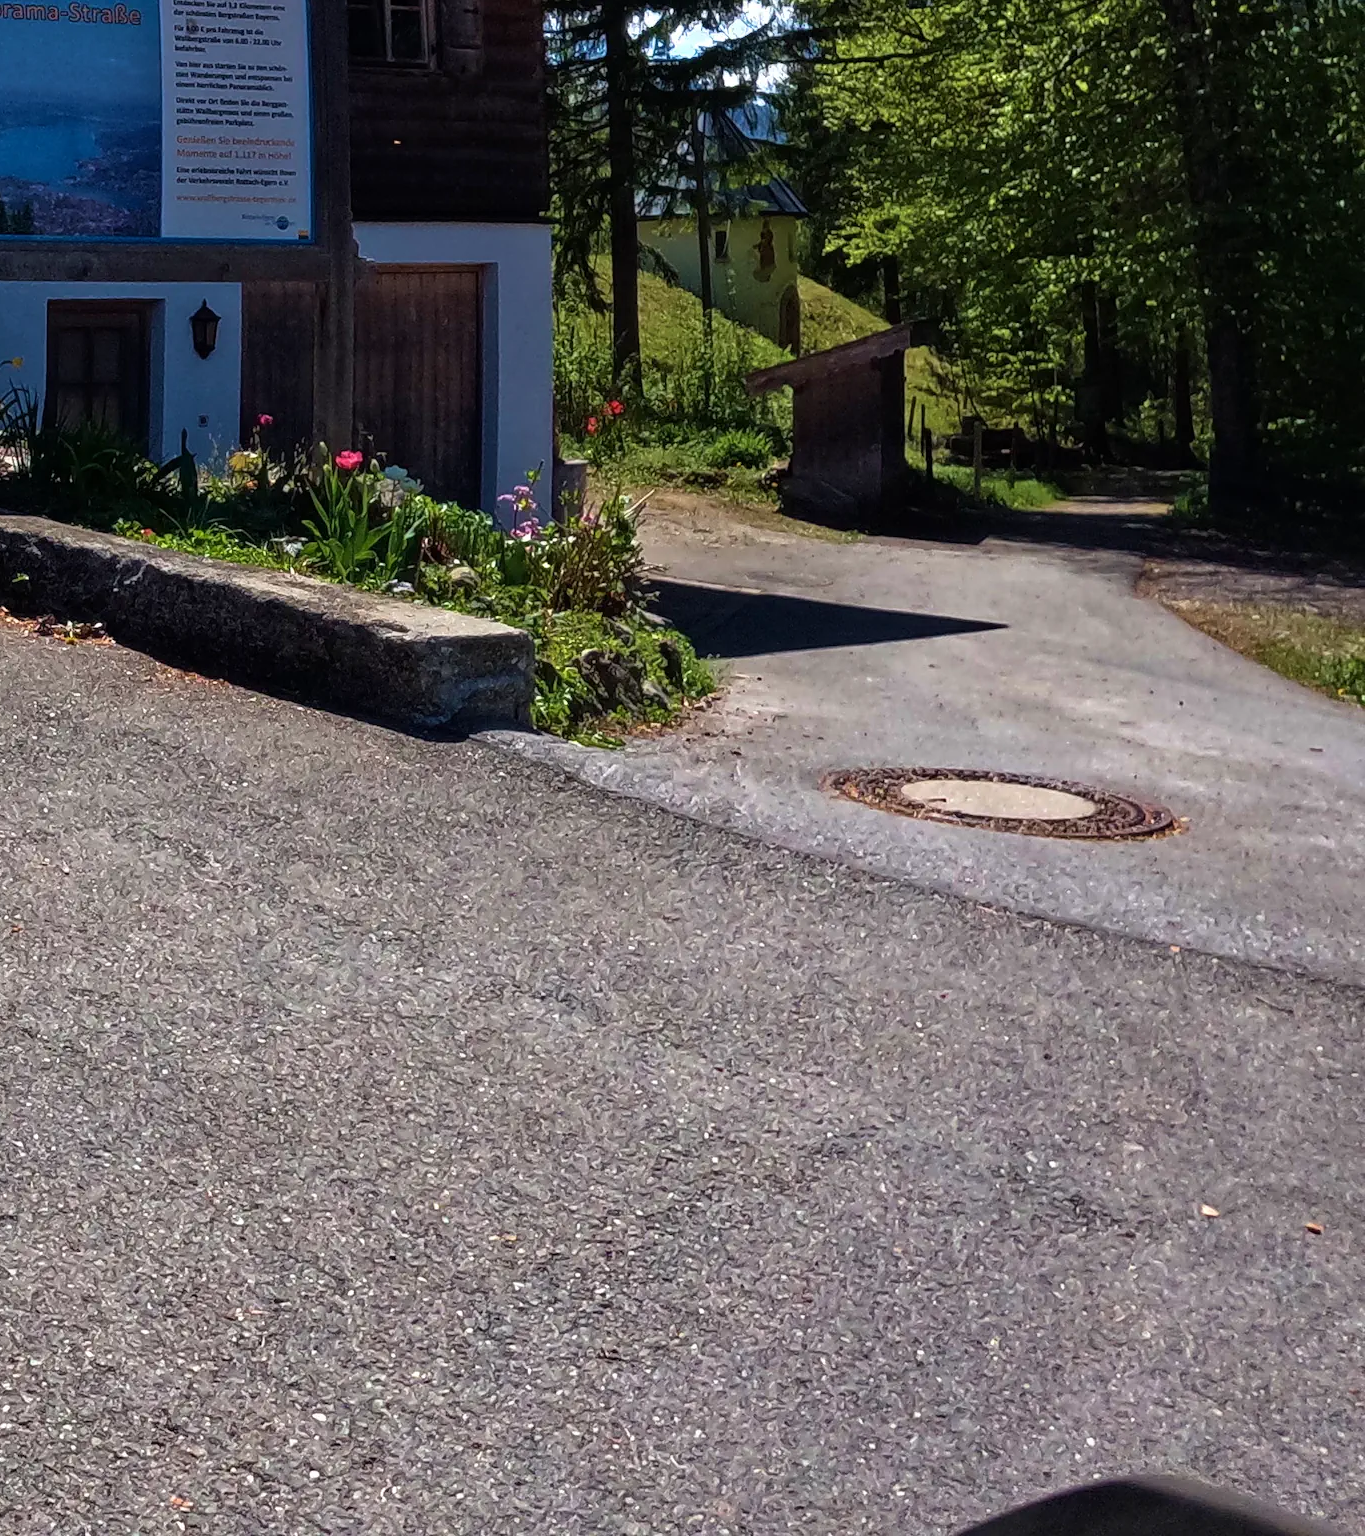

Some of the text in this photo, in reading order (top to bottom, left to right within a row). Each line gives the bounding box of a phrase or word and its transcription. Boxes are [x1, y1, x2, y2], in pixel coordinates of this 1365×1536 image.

[176, 135, 216, 144] Genießen
[218, 136, 231, 145] Sie
[176, 149, 217, 159] Momente
[218, 150, 233, 159] auf
